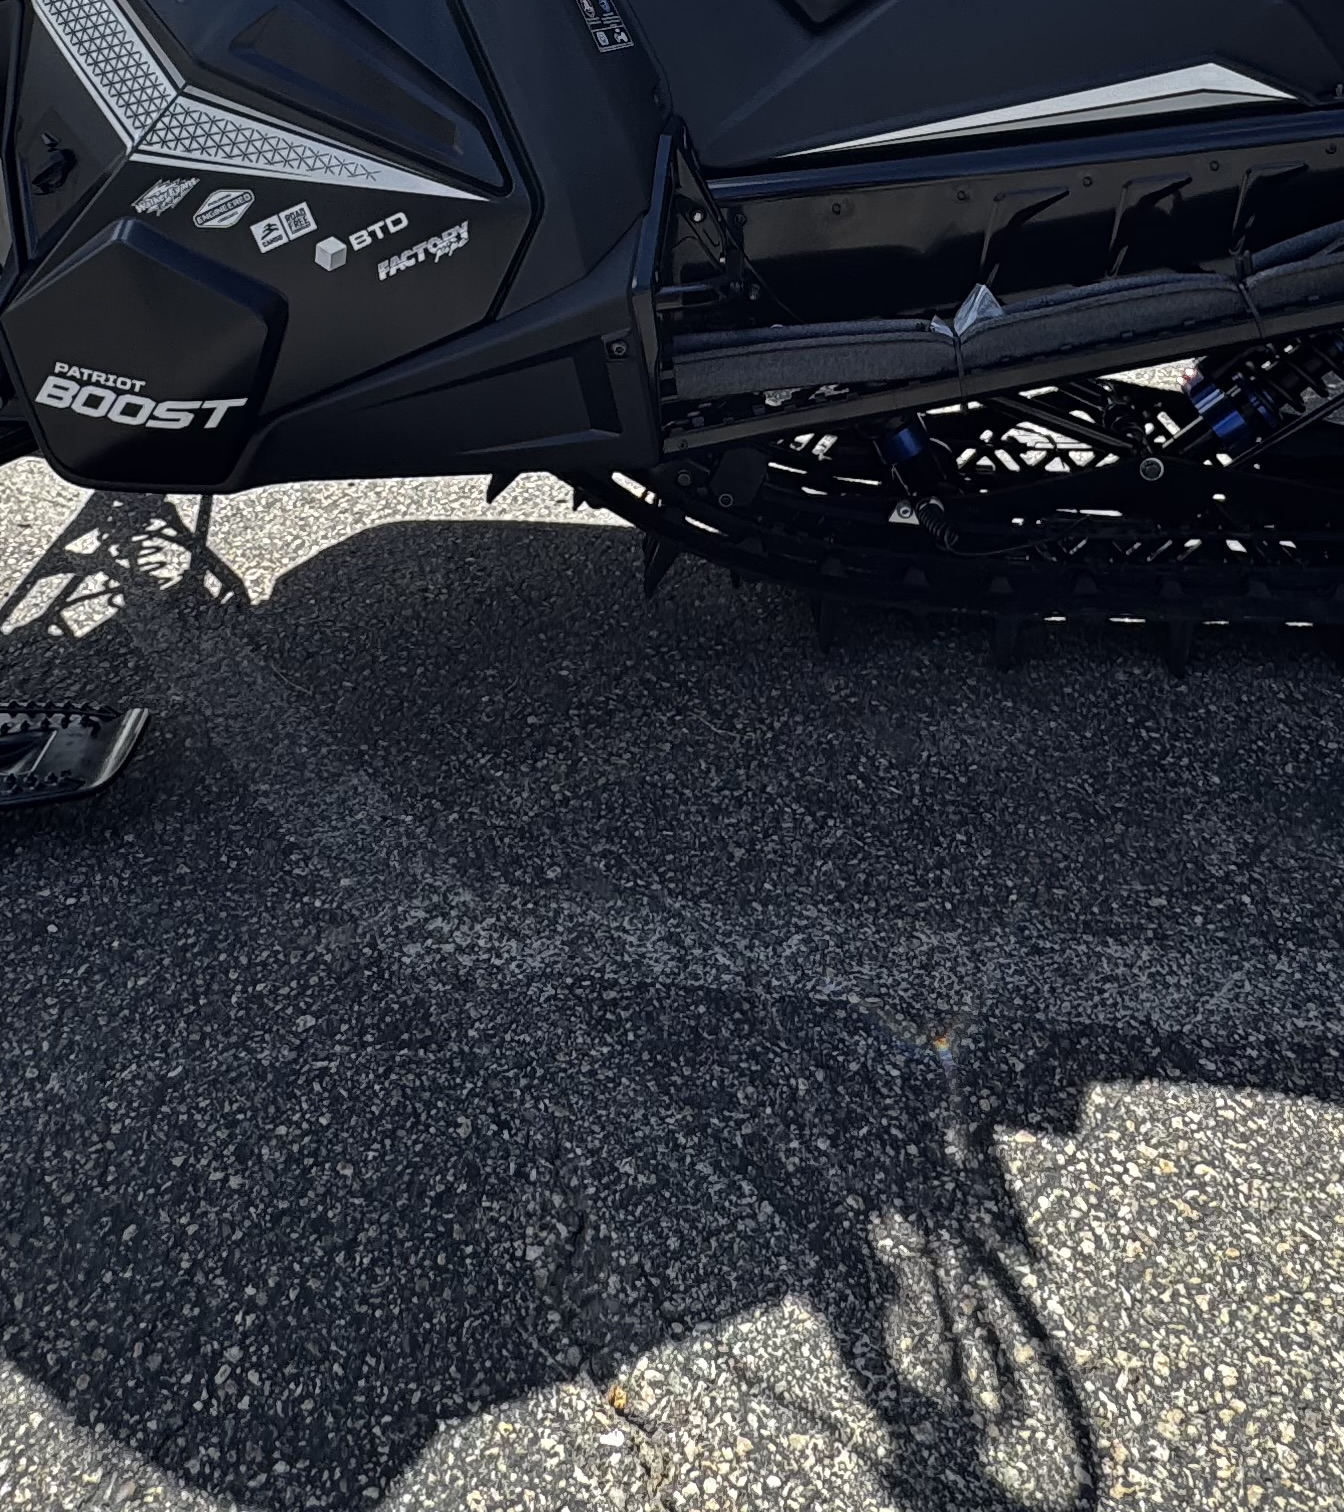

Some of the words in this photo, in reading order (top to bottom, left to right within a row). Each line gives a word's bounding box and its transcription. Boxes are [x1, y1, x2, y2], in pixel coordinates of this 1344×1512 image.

[196, 191, 251, 226] ENGINEERED
[288, 215, 309, 230] FREE
[349, 212, 409, 251] BTD
[377, 220, 469, 281] FACTORY
[54, 361, 146, 393] PATRIOT
[35, 375, 248, 430] BOOST
